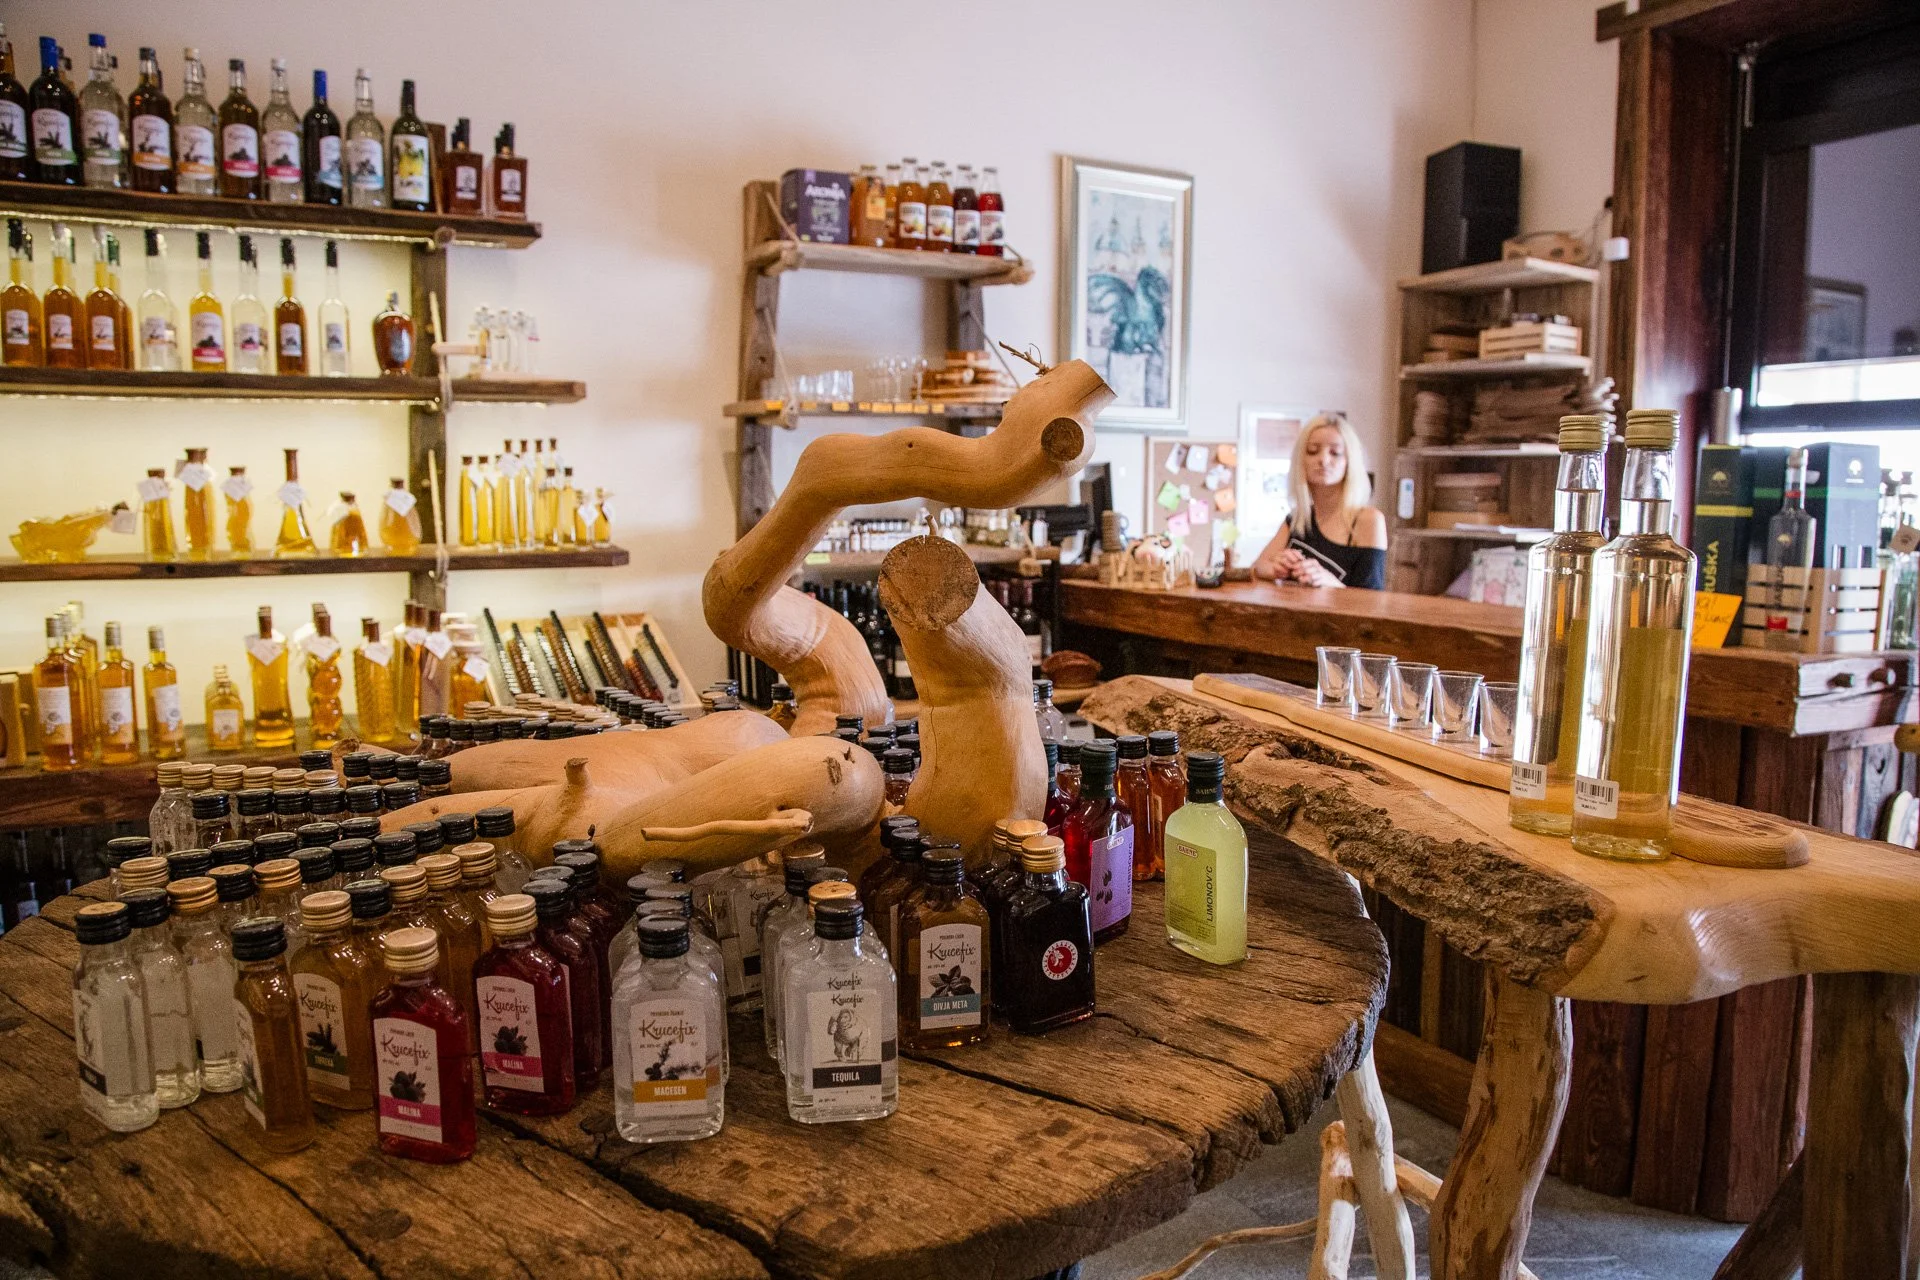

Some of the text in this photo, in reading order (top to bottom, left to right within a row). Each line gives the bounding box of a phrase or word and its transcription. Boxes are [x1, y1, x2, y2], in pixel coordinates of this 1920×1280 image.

[927, 941, 975, 964] Krucefix
[300, 989, 338, 1019] Krucefix
[483, 992, 530, 1021] Krucefix
[831, 994, 864, 1008] Krucefix
[933, 1000, 968, 1011] DIVJA META
[638, 1019, 697, 1044] Krucefix
[381, 1033, 430, 1066] Krucefix
[832, 1071, 860, 1083] TEQUILA
[654, 1085, 687, 1097] MACESEN
